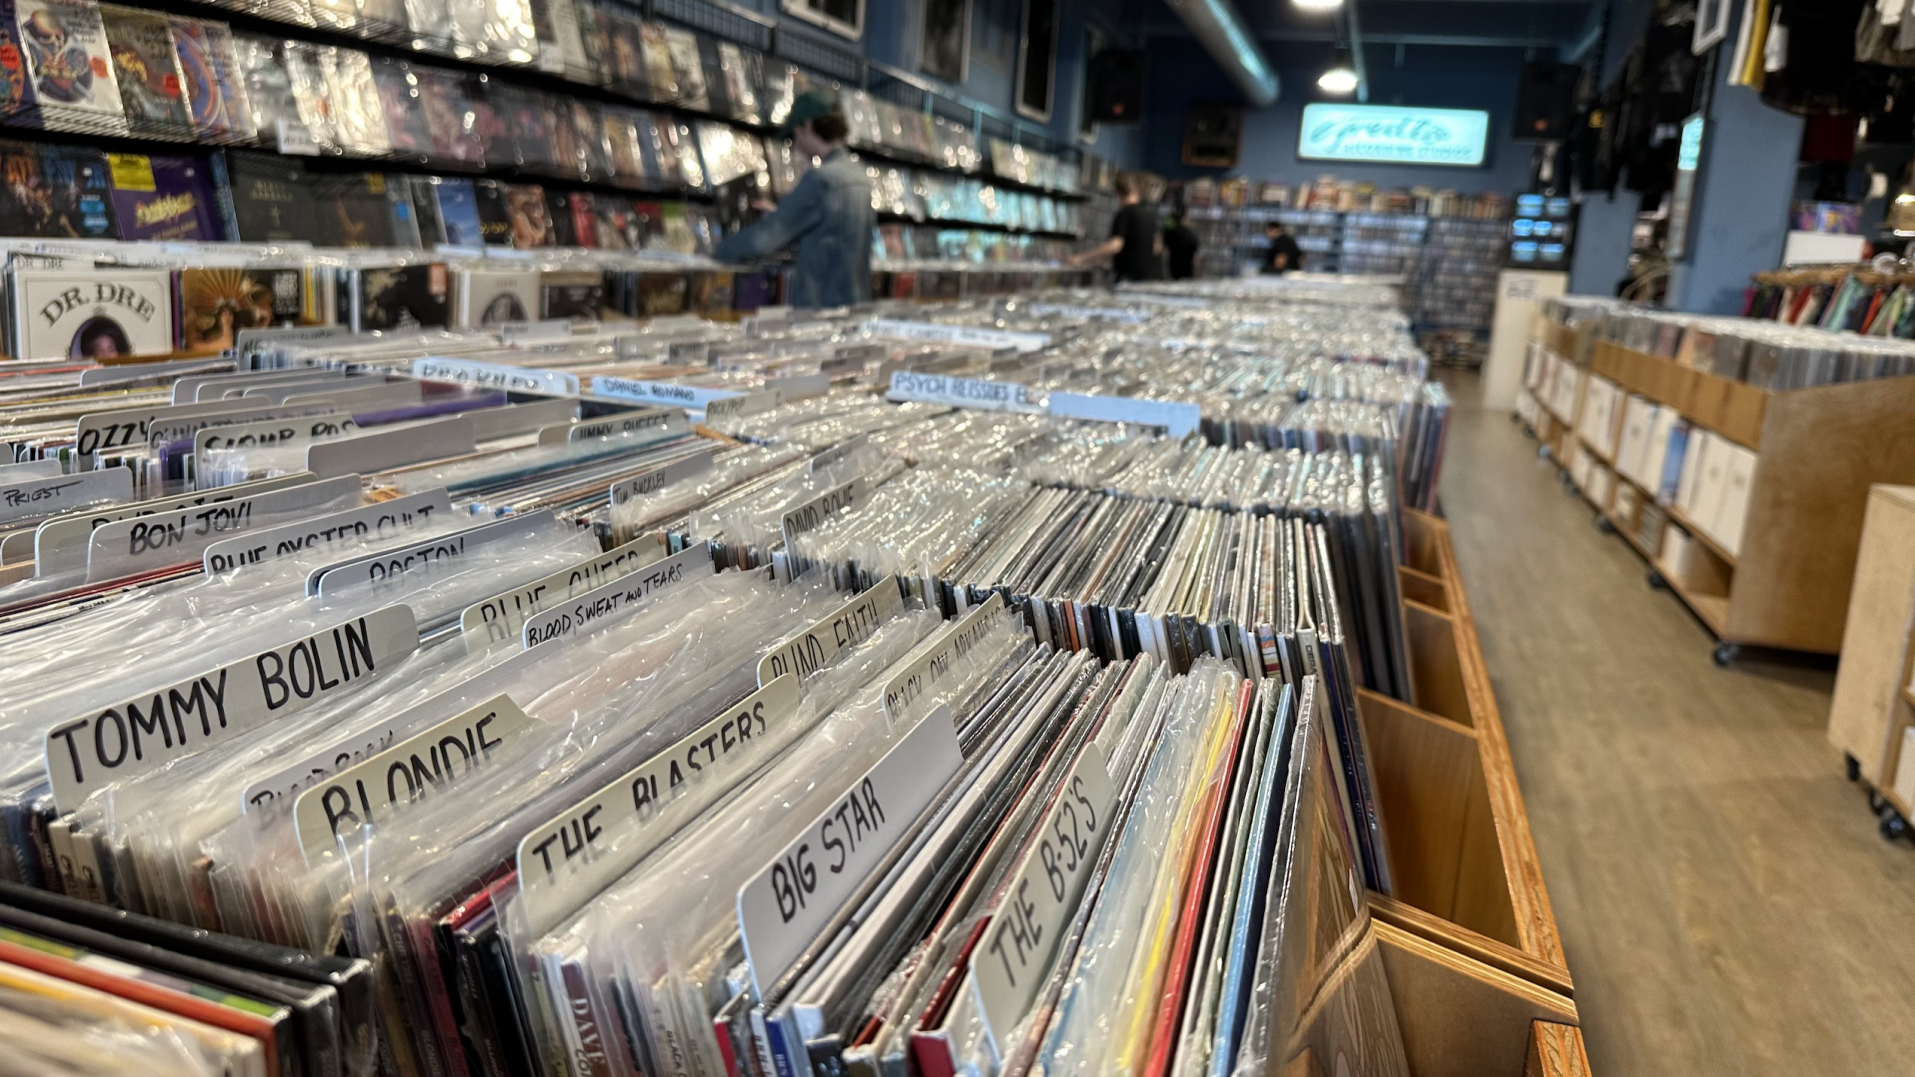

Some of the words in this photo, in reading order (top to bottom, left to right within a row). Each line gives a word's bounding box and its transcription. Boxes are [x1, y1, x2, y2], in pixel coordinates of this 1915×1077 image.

[94, 283, 155, 323] DRE
[651, 384, 695, 401] ROMANO
[894, 373, 946, 393] PSYCH
[951, 376, 1010, 401] REISSUES
[78, 415, 155, 456] OZZY
[3, 480, 84, 507] PRIEST
[633, 470, 666, 495] BUCKLEY
[129, 516, 187, 556] BON
[195, 501, 252, 536] JOVI
[786, 505, 819, 537] DAVID
[575, 591, 624, 626] SWEAT
[625, 588, 642, 604] AND
[643, 563, 683, 594] TEARS
[51, 668, 227, 783] TOMMY
[256, 617, 375, 710] BOLIN
[321, 711, 503, 842] BLONDIE
[531, 803, 603, 878] THE
[631, 700, 767, 815] BLASTERS
[771, 843, 817, 924] BIG
[821, 776, 886, 874] STAR
[989, 877, 1043, 988] THE
[571, 999, 605, 1065] DAVE
